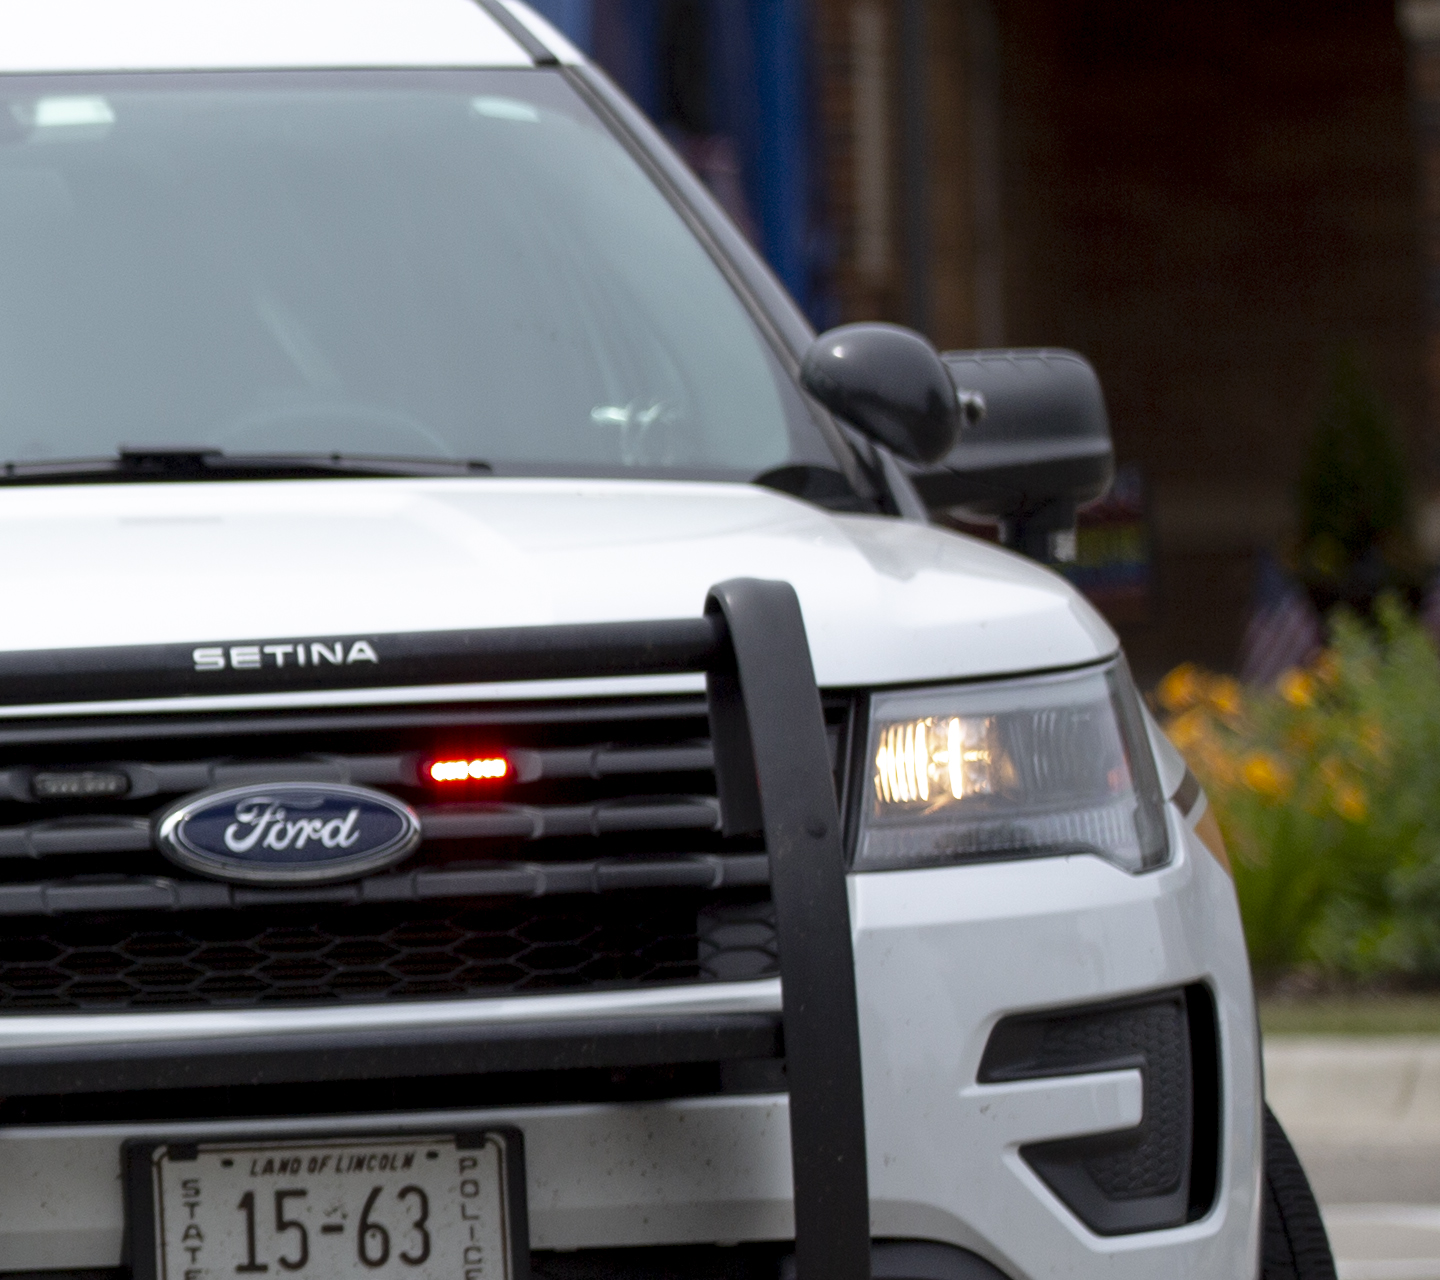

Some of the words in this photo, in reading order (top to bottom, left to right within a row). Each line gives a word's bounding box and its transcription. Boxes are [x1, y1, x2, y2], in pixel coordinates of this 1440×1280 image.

[192, 640, 378, 671] SETINA
[224, 794, 359, 853] Ford
[249, 1157, 301, 1177] LAND
[307, 1155, 331, 1175] OF
[335, 1151, 416, 1174] LINCOLN
[235, 1184, 432, 1273] 15-63
